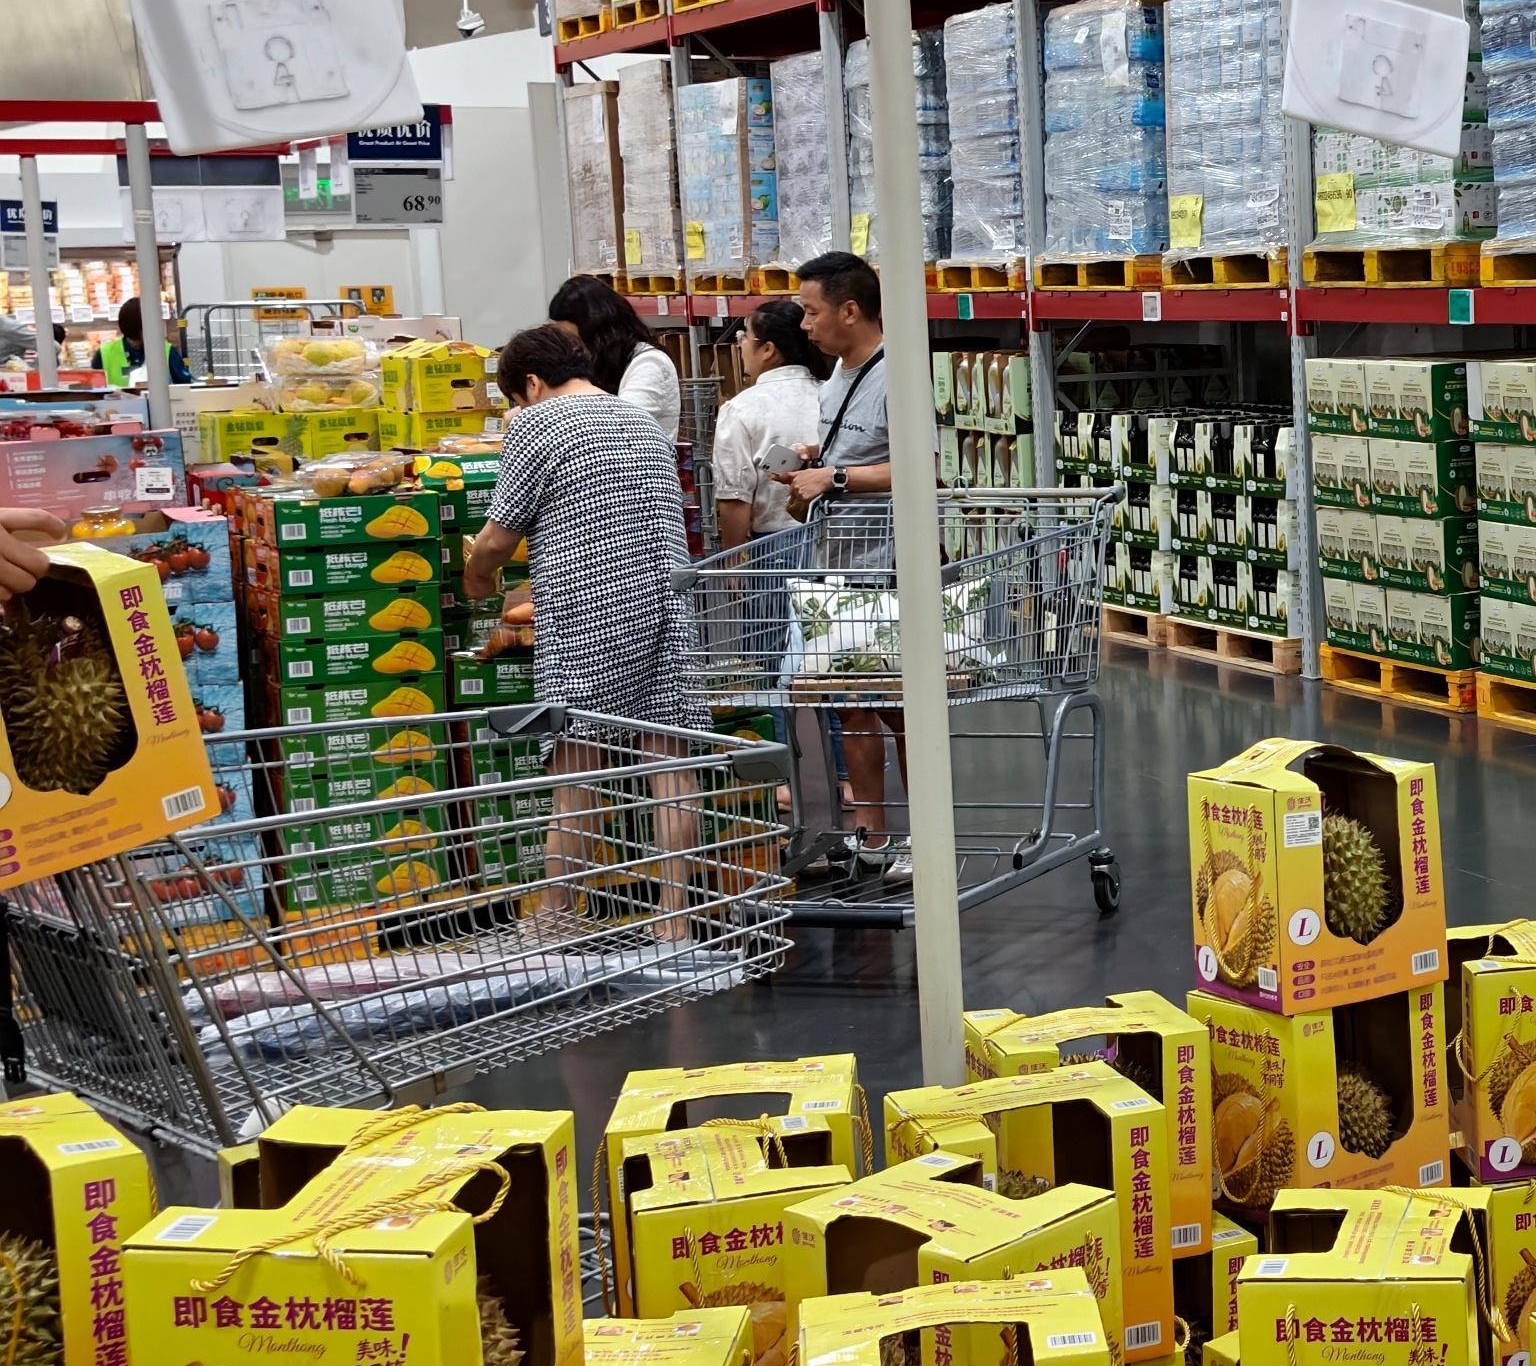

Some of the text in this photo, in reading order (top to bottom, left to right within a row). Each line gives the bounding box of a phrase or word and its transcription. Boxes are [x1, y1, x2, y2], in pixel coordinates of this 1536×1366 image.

[119, 584, 178, 726] 即食金枕榴莲
[1410, 778, 1431, 895] 即食金枕榴莲
[1296, 917, 1312, 938] L
[1204, 954, 1213, 973] L
[1420, 993, 1439, 1109] 即食金枕榴莲
[1176, 1045, 1198, 1167] 即食金枕榴莲
[1177, 1045, 1197, 1167] 即食金枕榴莲
[1316, 1140, 1328, 1161] L
[1495, 1140, 1516, 1167] L
[1130, 1125, 1155, 1260] 即食金枕榴莲
[173, 1296, 396, 1332] 即食金枕榴莲
[1274, 1315, 1438, 1344] 即食金枕榴莲
[356, 1332, 411, 1363] 美味!
